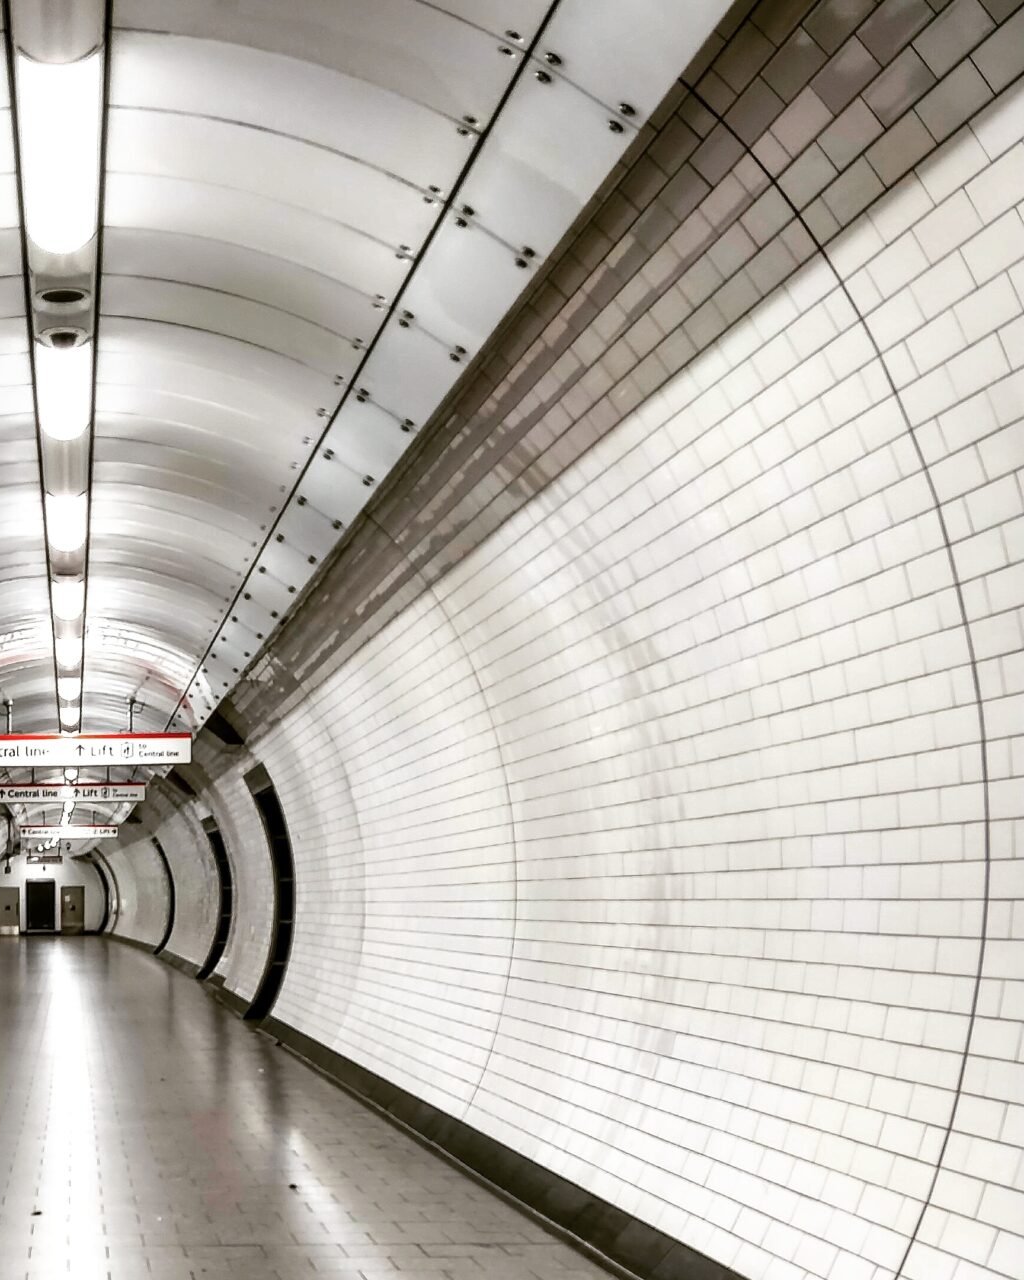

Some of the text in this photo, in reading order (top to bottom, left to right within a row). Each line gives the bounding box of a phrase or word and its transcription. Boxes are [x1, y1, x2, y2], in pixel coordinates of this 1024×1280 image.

[91, 745, 114, 757] Lift
[7, 789, 58, 798] Central line
[82, 789, 98, 797] Lift
